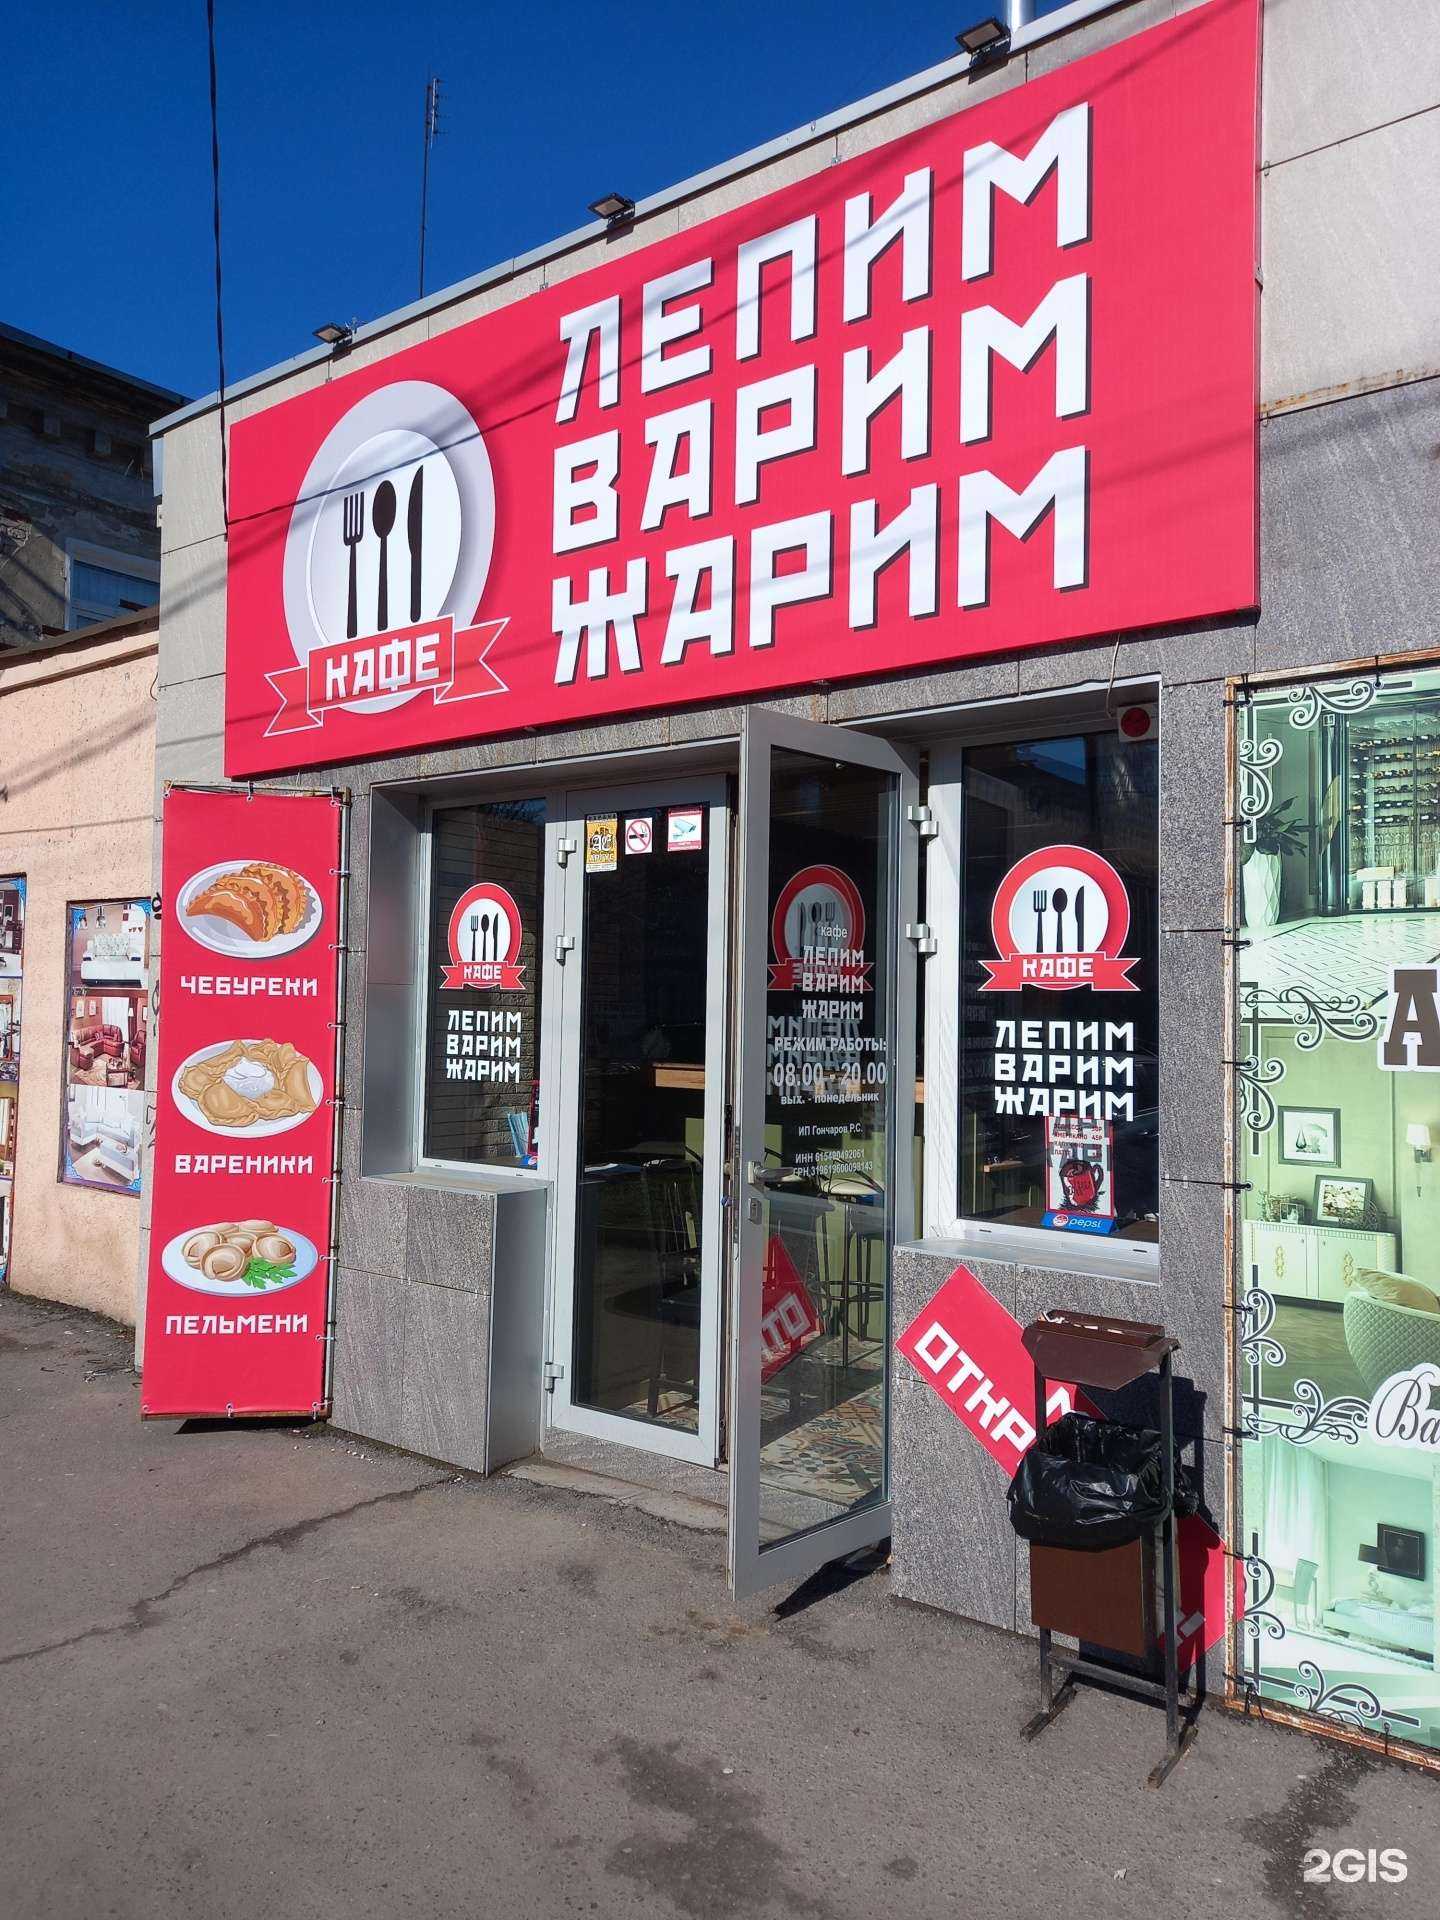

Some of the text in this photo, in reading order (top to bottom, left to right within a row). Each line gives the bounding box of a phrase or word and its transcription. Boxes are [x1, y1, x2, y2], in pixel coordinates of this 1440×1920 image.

[555, 101, 1090, 424] ЛЕПИМ
[552, 272, 1089, 556] ВАРИМ
[552, 445, 1087, 685] ЖАРИМ
[325, 632, 440, 701] КАФЕ
[820, 923, 848, 941] кафе
[803, 945, 865, 968] ЛЕПИМ
[1022, 956, 1094, 979] КАФЕ
[463, 963, 503, 980] КАФЕ
[802, 972, 864, 994] ВАРИМ
[180, 975, 318, 997] ЧЕБУРЕКИ
[447, 1009, 522, 1033] ЛЕПИМ
[801, 999, 864, 1020] ЖАРИМ
[446, 1033, 521, 1059] ВАРИМ
[774, 1036, 889, 1052] РЕЖИМ РАБОТЫ:
[994, 1020, 1134, 1052] ЛЕПИМ
[446, 1058, 521, 1084] ЖАРИМ
[773, 1062, 824, 1087] 08.00
[841, 1062, 887, 1086] 20.00
[994, 1053, 1134, 1087] ВАРИМ
[813, 1092, 880, 1105] понедельник
[994, 1086, 1134, 1122] ЖАРИМ
[798, 1125, 811, 1137] ИП
[812, 1124, 848, 1137] Гончаров
[174, 1154, 313, 1174] ВАРЕНИКИ
[795, 1152, 814, 1165] ИНН
[1068, 1216, 1102, 1229] pepsi
[165, 1314, 309, 1335] ПЕЛЬМЕНИ
